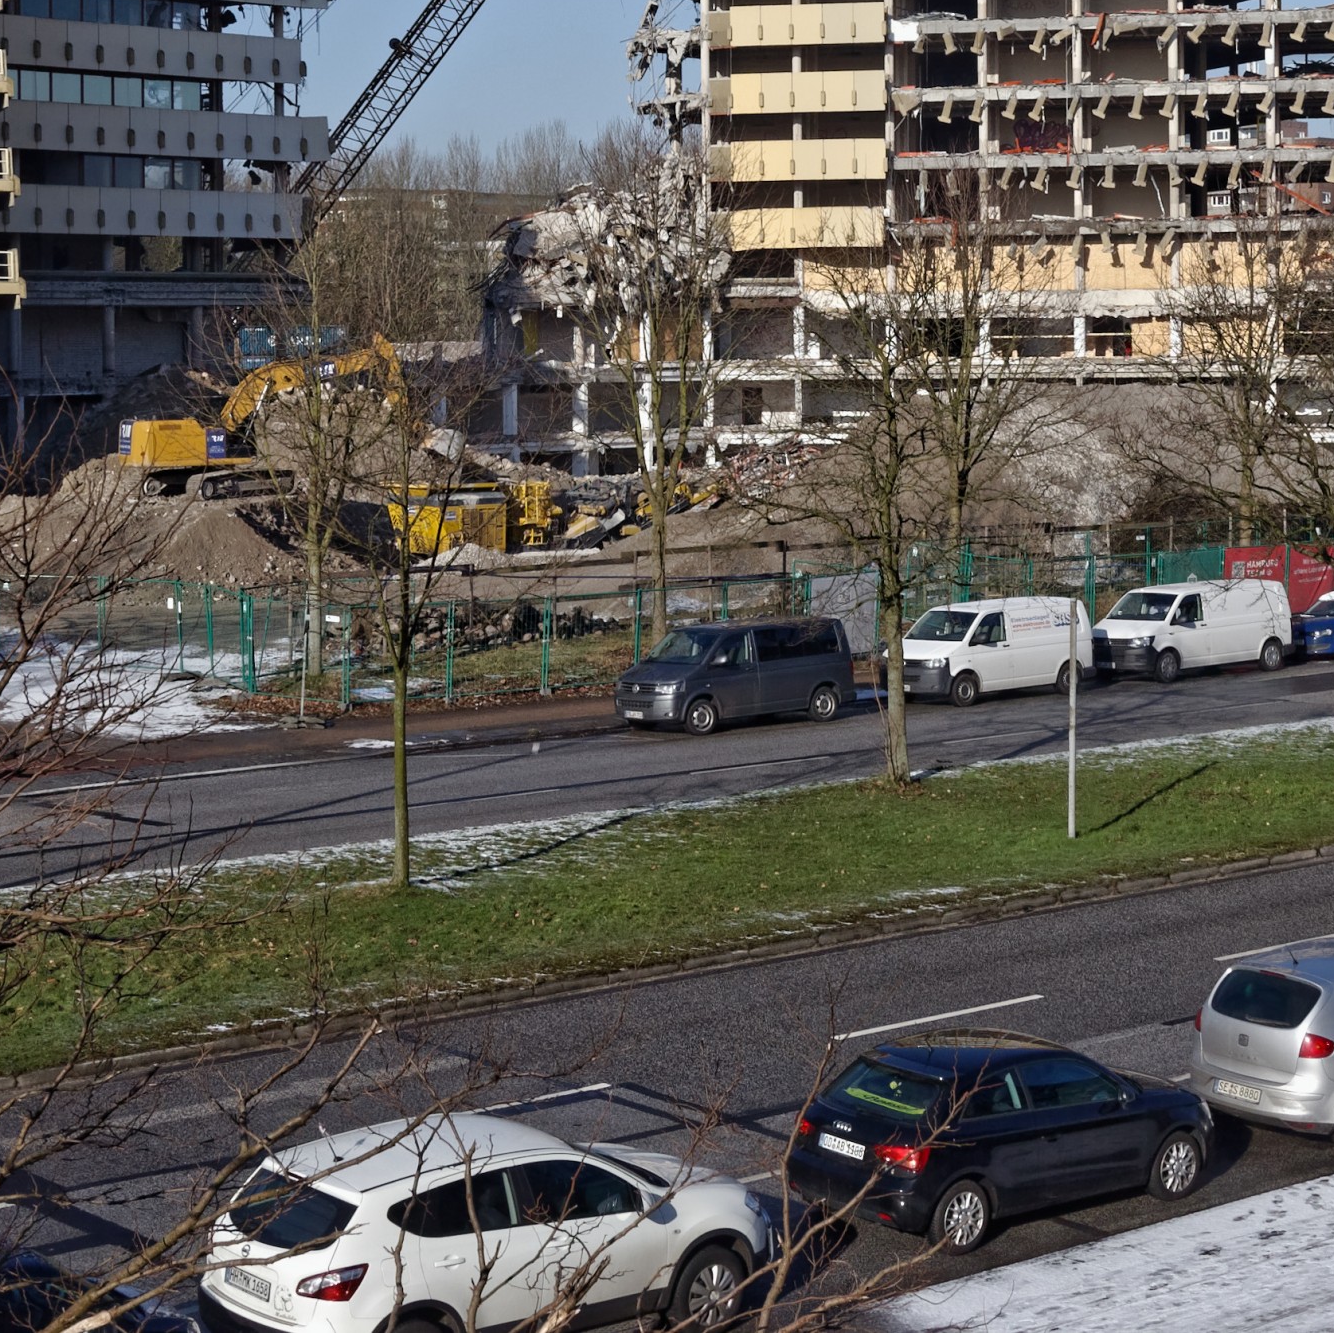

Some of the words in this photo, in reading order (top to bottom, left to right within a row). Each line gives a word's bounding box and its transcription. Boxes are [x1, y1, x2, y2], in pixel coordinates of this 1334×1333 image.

[1219, 1081, 1229, 1093] SE
[1239, 1086, 1260, 1101] 8880
[823, 1135, 833, 1148] OD
[252, 1278, 269, 1297] 1658
